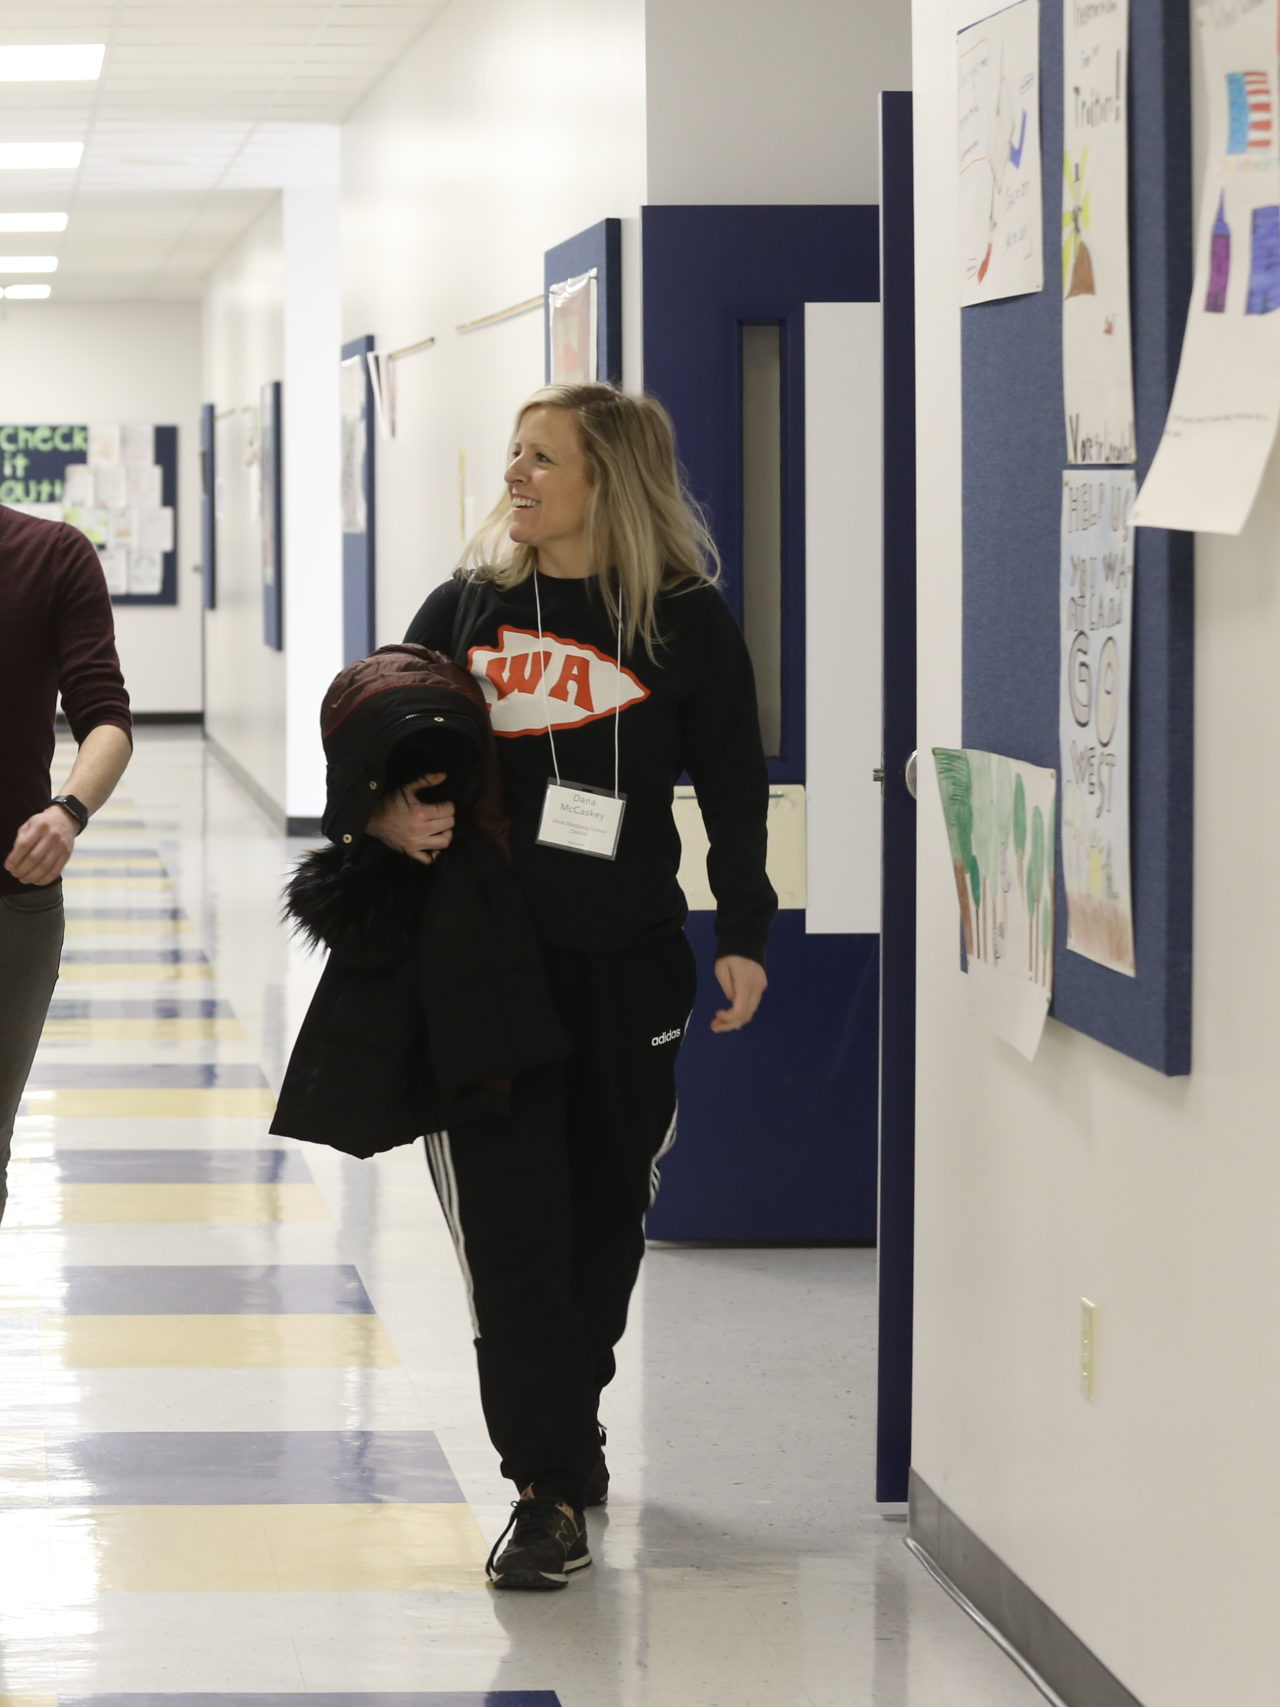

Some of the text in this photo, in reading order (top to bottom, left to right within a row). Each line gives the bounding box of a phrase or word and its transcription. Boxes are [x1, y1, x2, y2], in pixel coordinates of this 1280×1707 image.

[3, 452, 30, 479] it
[485, 651, 595, 713] WA
[1067, 629, 1118, 748] GO
[572, 793, 597, 806] Dana
[1070, 740, 1117, 819] WEST
[651, 1028, 681, 1047] adidas
